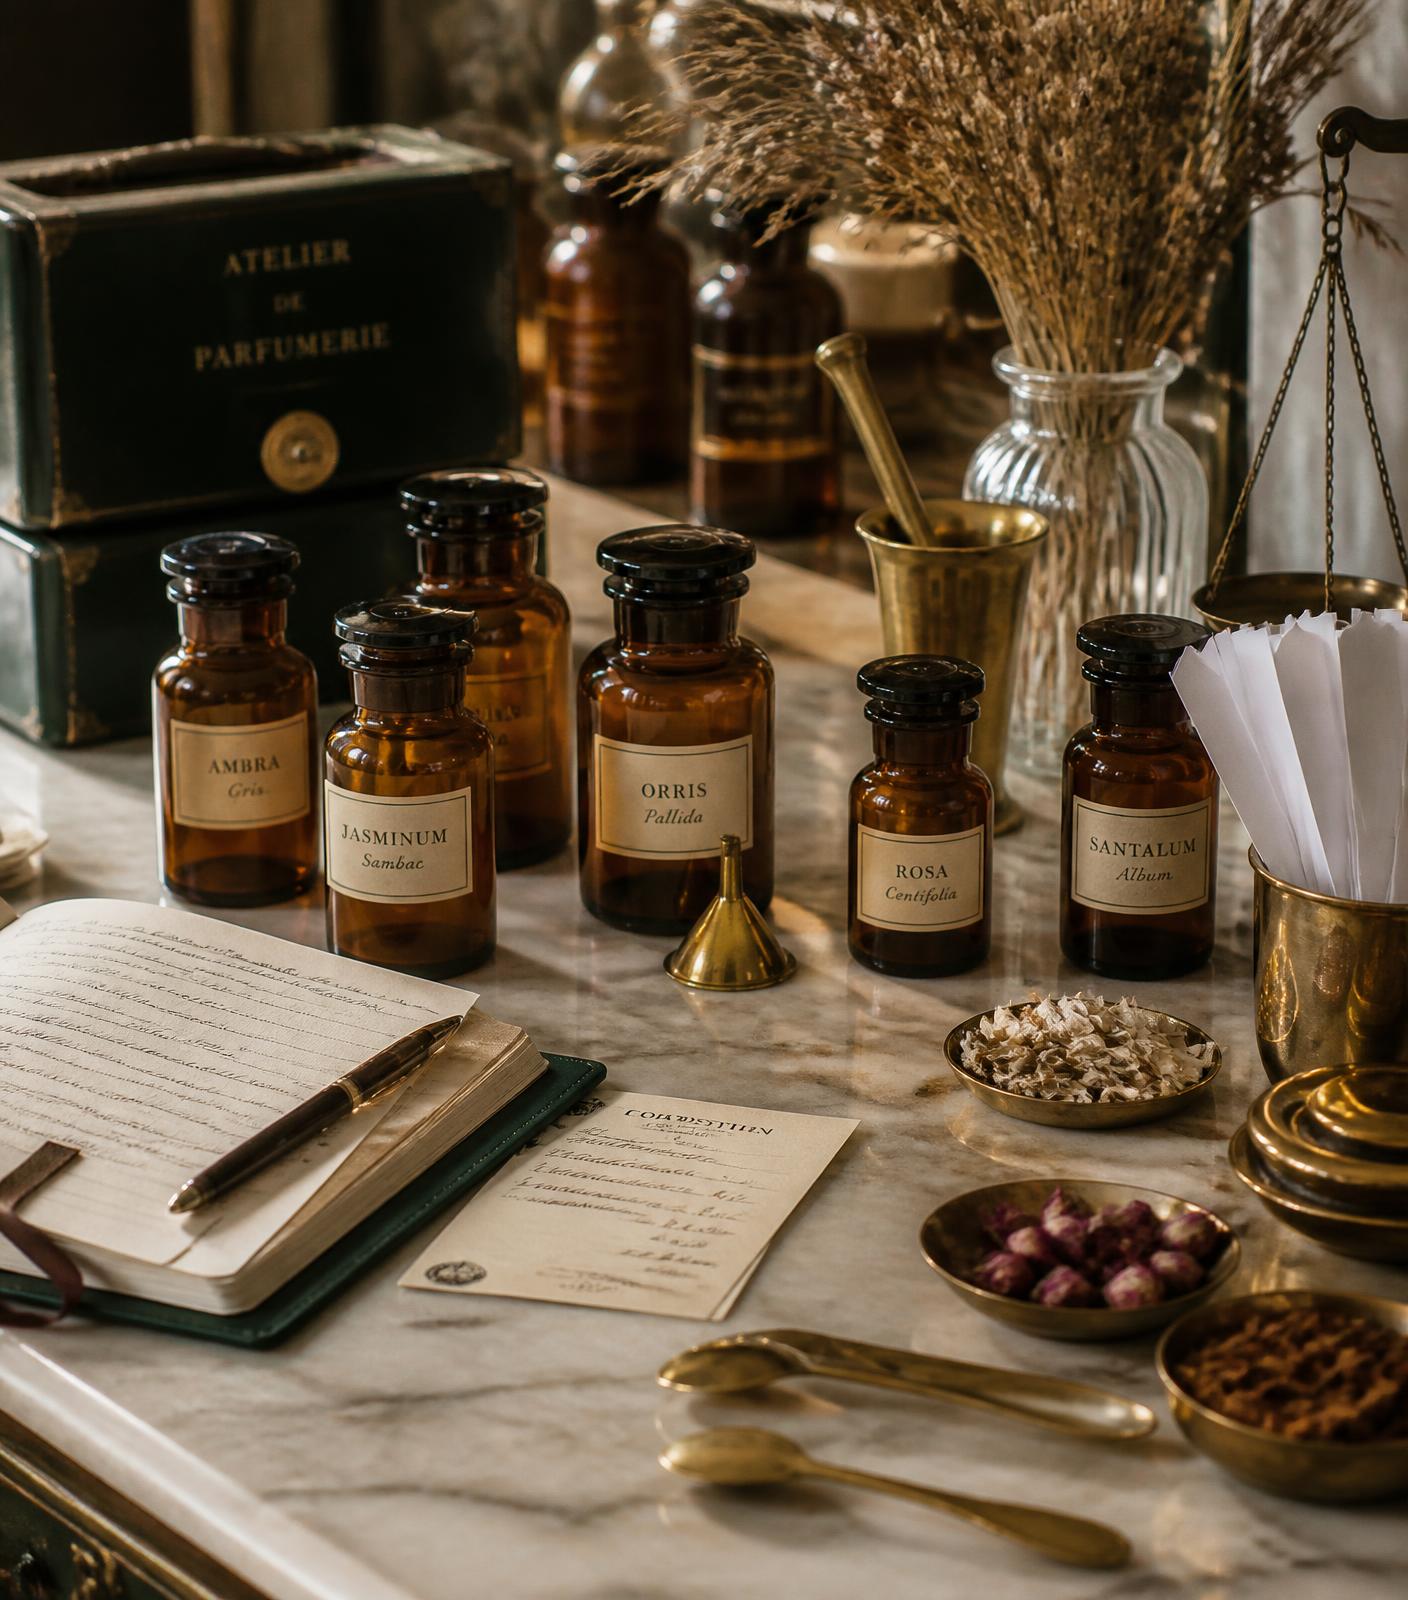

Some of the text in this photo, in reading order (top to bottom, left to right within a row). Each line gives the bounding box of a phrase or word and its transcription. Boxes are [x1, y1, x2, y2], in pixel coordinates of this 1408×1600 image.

[224, 239, 351, 278] ATELIER
[273, 292, 304, 314] DE
[194, 322, 390, 371] PARFUMERIE
[208, 755, 280, 775] AMBRA
[228, 782, 264, 799] Gris
[641, 782, 707, 799] ORRIS
[644, 808, 703, 824] Pallida
[341, 824, 448, 846] JASMINUM
[1089, 836, 1196, 858] SANTALUM
[361, 853, 425, 870] Sambac
[896, 864, 948, 880] ROSA
[1115, 867, 1174, 882] Album
[885, 886, 957, 906] Centifolia
